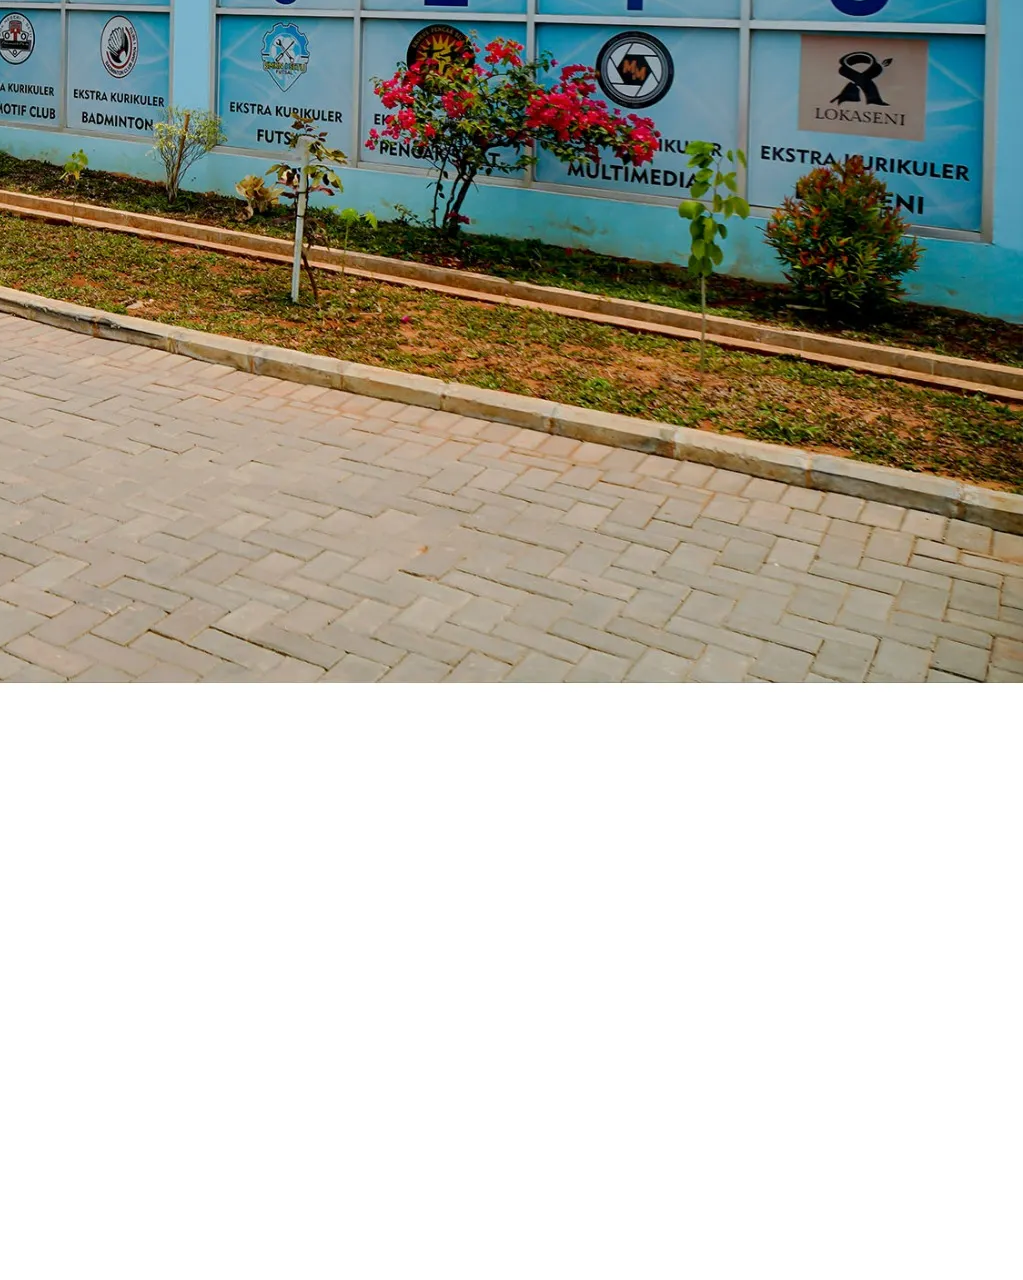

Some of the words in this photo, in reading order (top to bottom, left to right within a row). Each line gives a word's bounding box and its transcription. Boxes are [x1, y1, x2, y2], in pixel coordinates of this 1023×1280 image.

[8, 83, 55, 96] KURIKULER
[73, 89, 107, 101] EKSTRA
[110, 92, 164, 107] KURIKULER
[29, 106, 56, 119] CLUB
[81, 111, 154, 131] BADMINTON
[229, 102, 272, 116] EKSTRA
[275, 105, 343, 123] KURIKULER
[814, 107, 906, 126] LOKASENI
[257, 129, 292, 145] FUTS
[760, 145, 835, 166] EKSTRA
[567, 160, 698, 189] MULTIMEDIA
